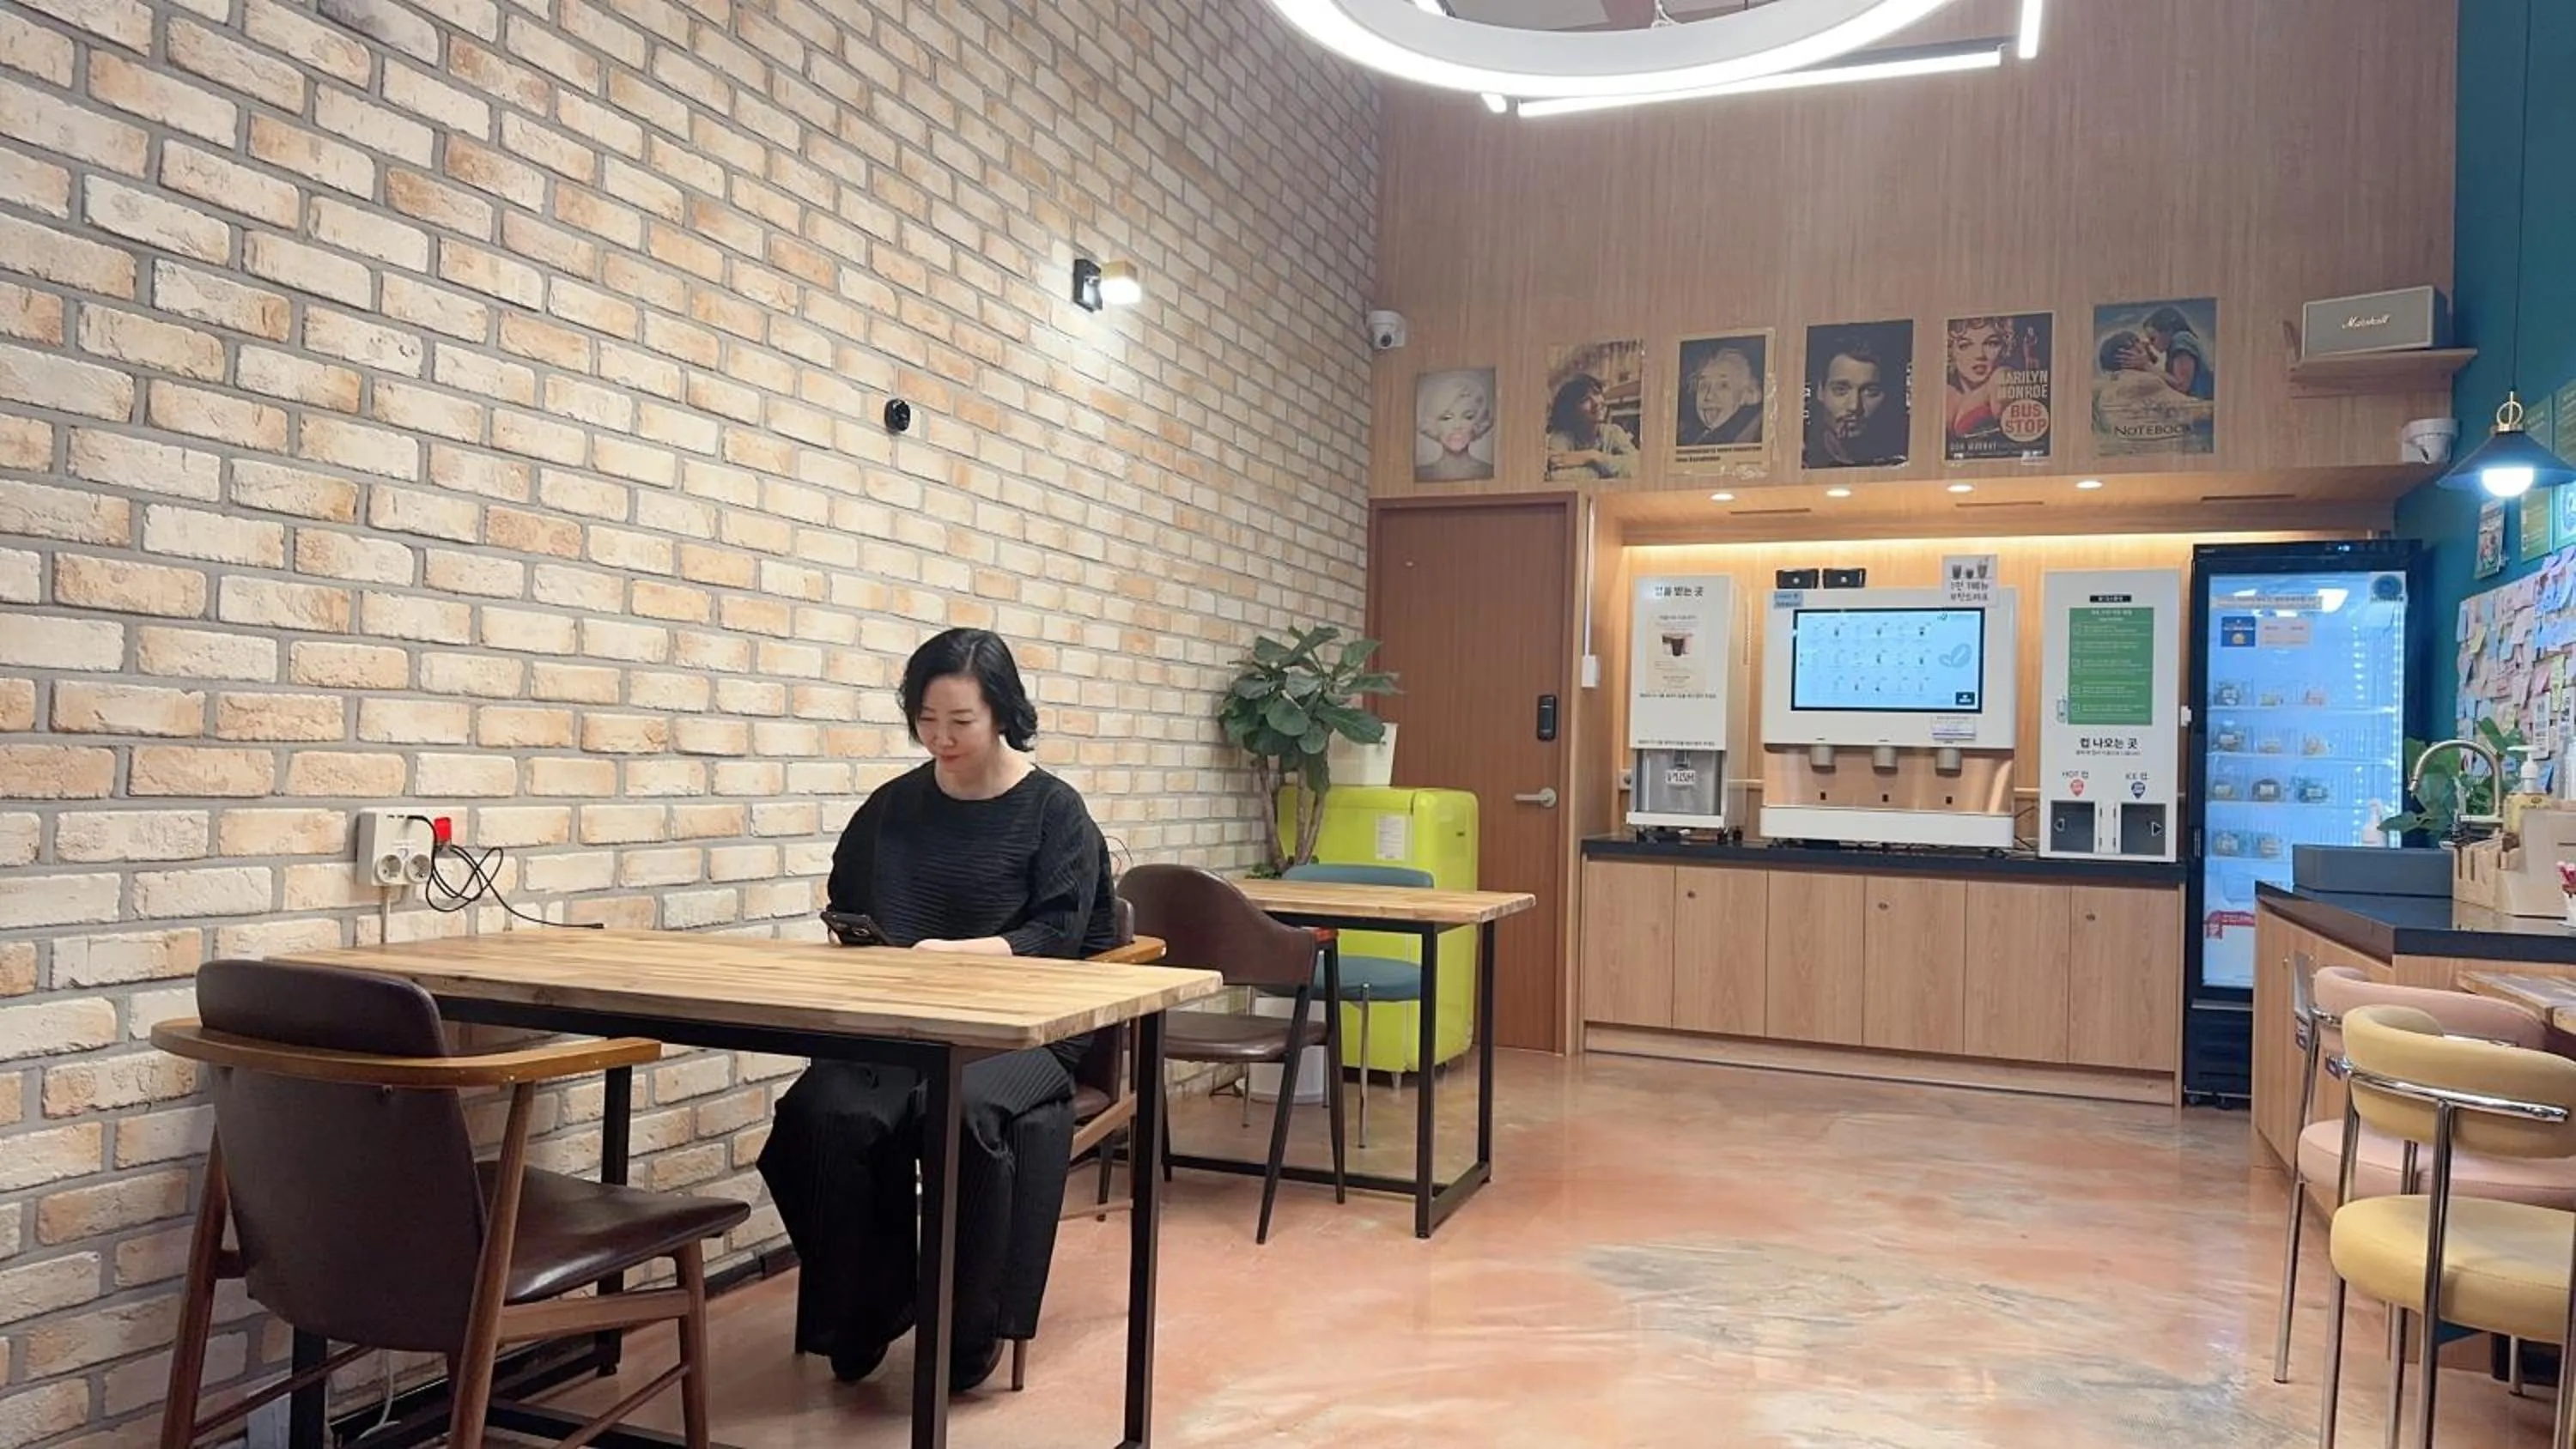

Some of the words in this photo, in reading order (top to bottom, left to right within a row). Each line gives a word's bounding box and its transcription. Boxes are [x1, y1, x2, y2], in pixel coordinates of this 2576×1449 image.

[2010, 404, 2041, 417] BUS
[2005, 419, 2047, 433] STOP
[1694, 586, 1704, 597] 곳
[2081, 737, 2090, 749] 컵
[2093, 737, 2124, 749] 나오는
[2128, 737, 2138, 749] 곳
